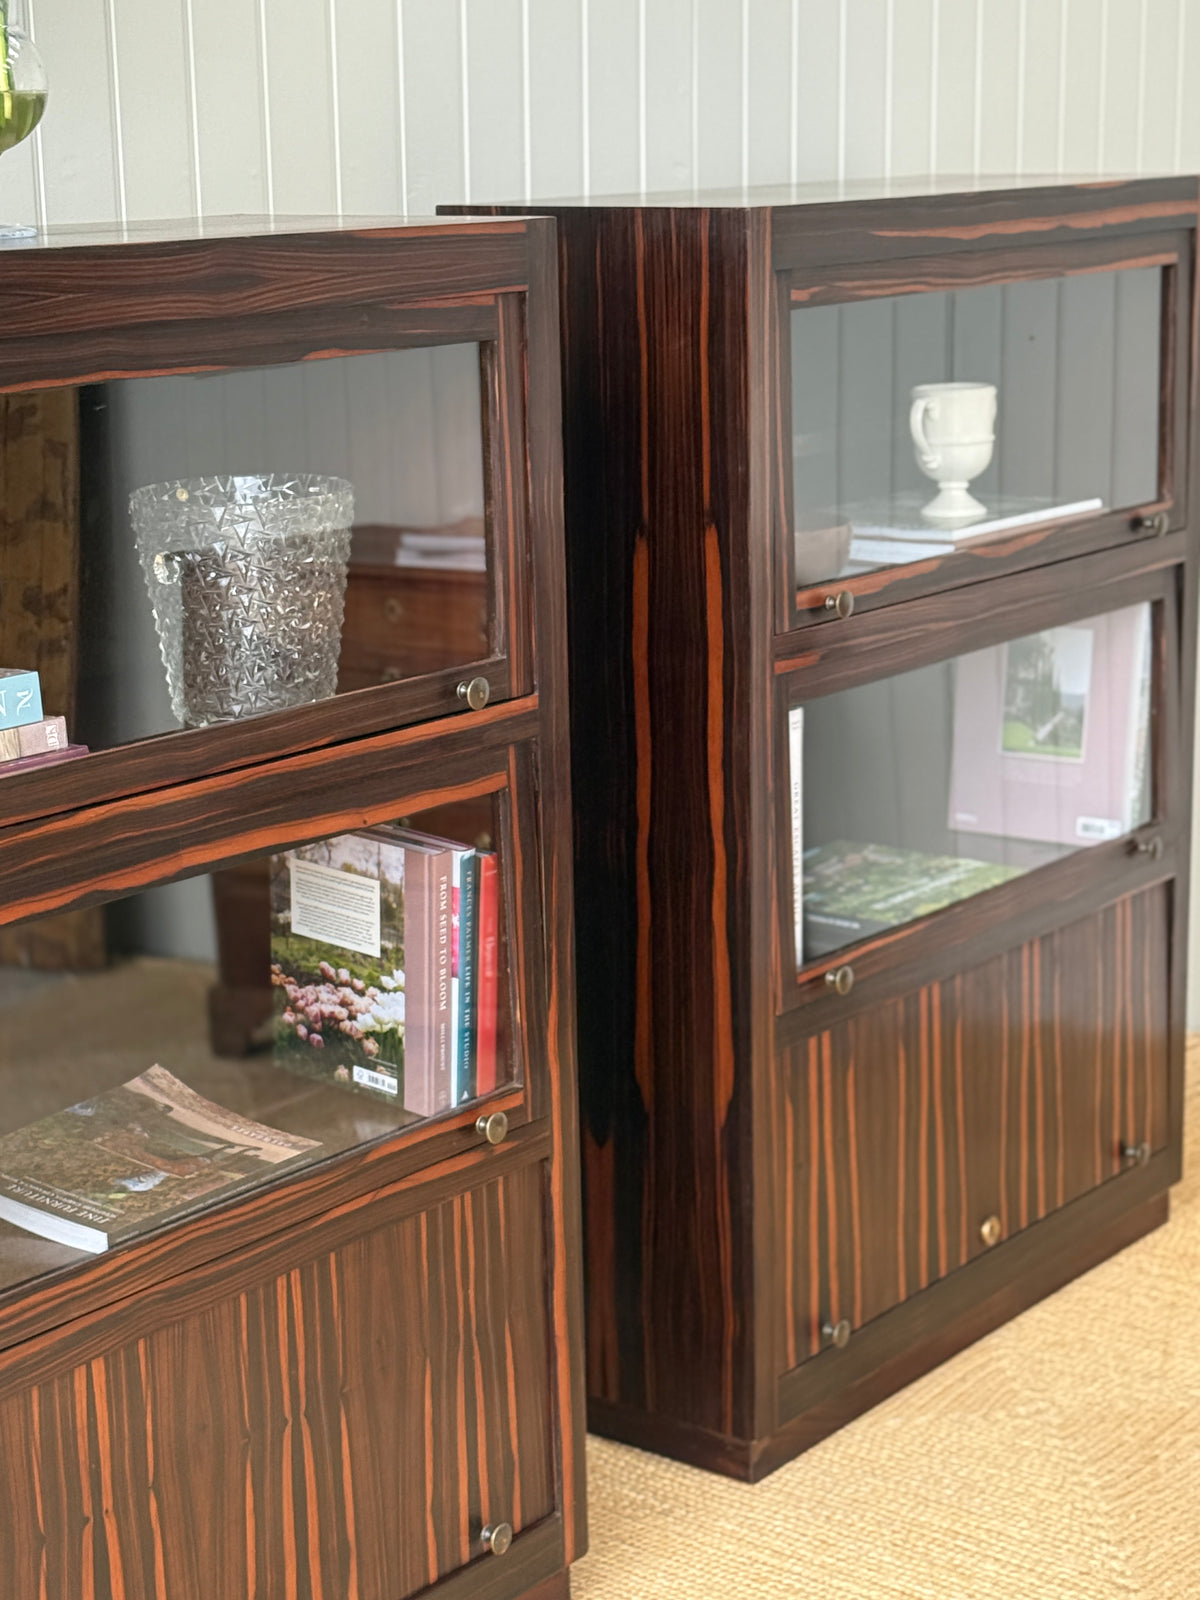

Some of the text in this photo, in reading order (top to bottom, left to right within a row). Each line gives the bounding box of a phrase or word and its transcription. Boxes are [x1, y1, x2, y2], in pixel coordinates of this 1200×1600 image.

[440, 948, 447, 965] TO
[439, 968, 447, 1011] BLOOM
[464, 991, 471, 1004] IN
[463, 1031, 471, 1070] STUDIO
[6, 1183, 79, 1214] FURNITURE
[76, 1211, 111, 1224] FINE
